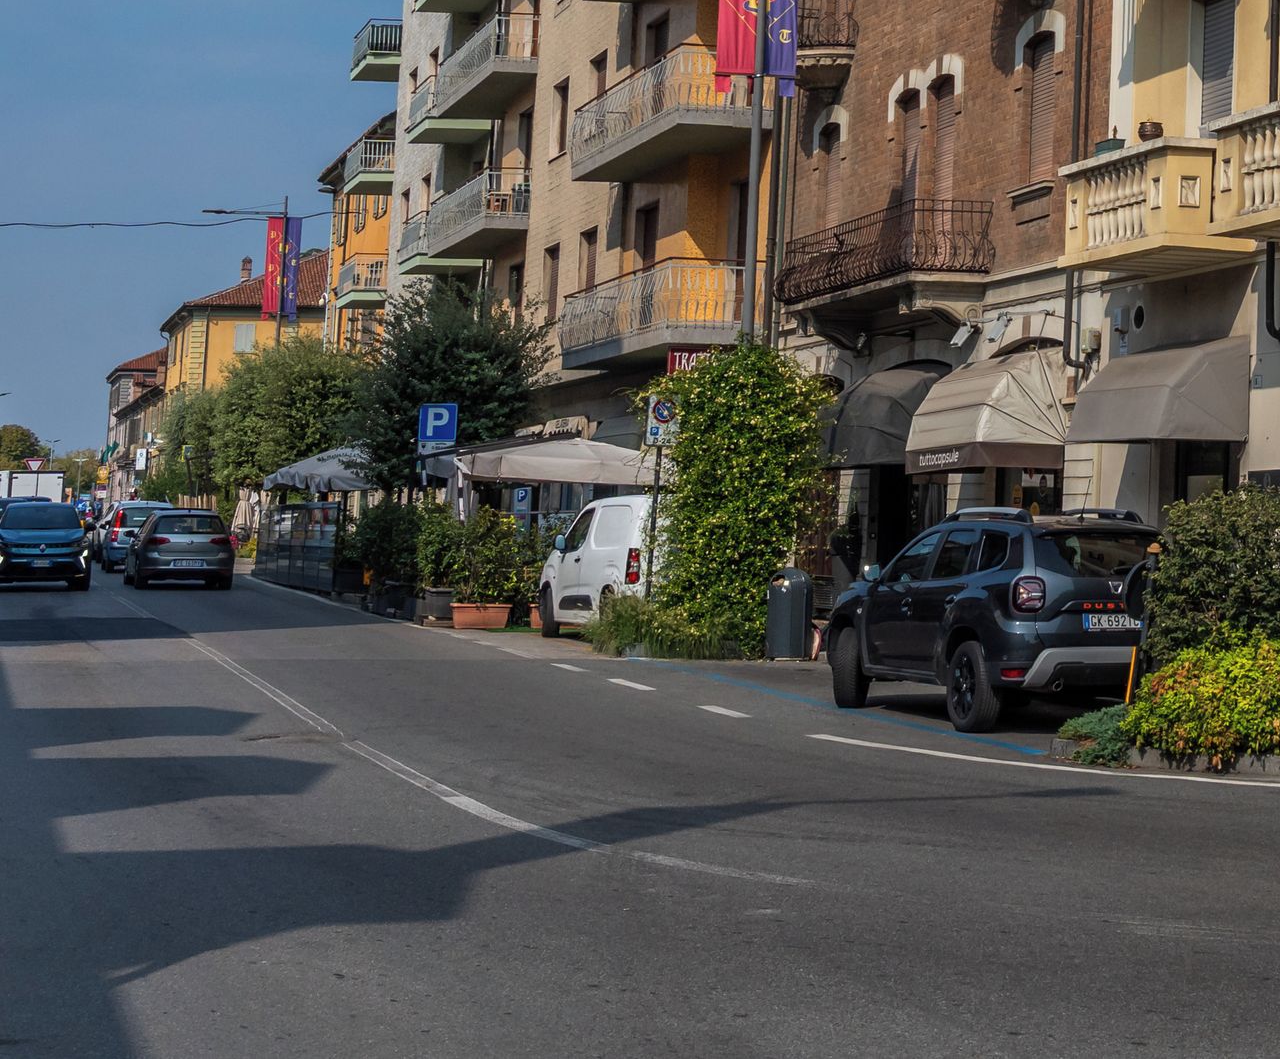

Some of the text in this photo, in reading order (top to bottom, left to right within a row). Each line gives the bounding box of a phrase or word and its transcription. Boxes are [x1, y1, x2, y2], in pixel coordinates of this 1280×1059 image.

[426, 407, 450, 437] P
[919, 448, 959, 468] tuttocapsule
[519, 490, 525, 500] P
